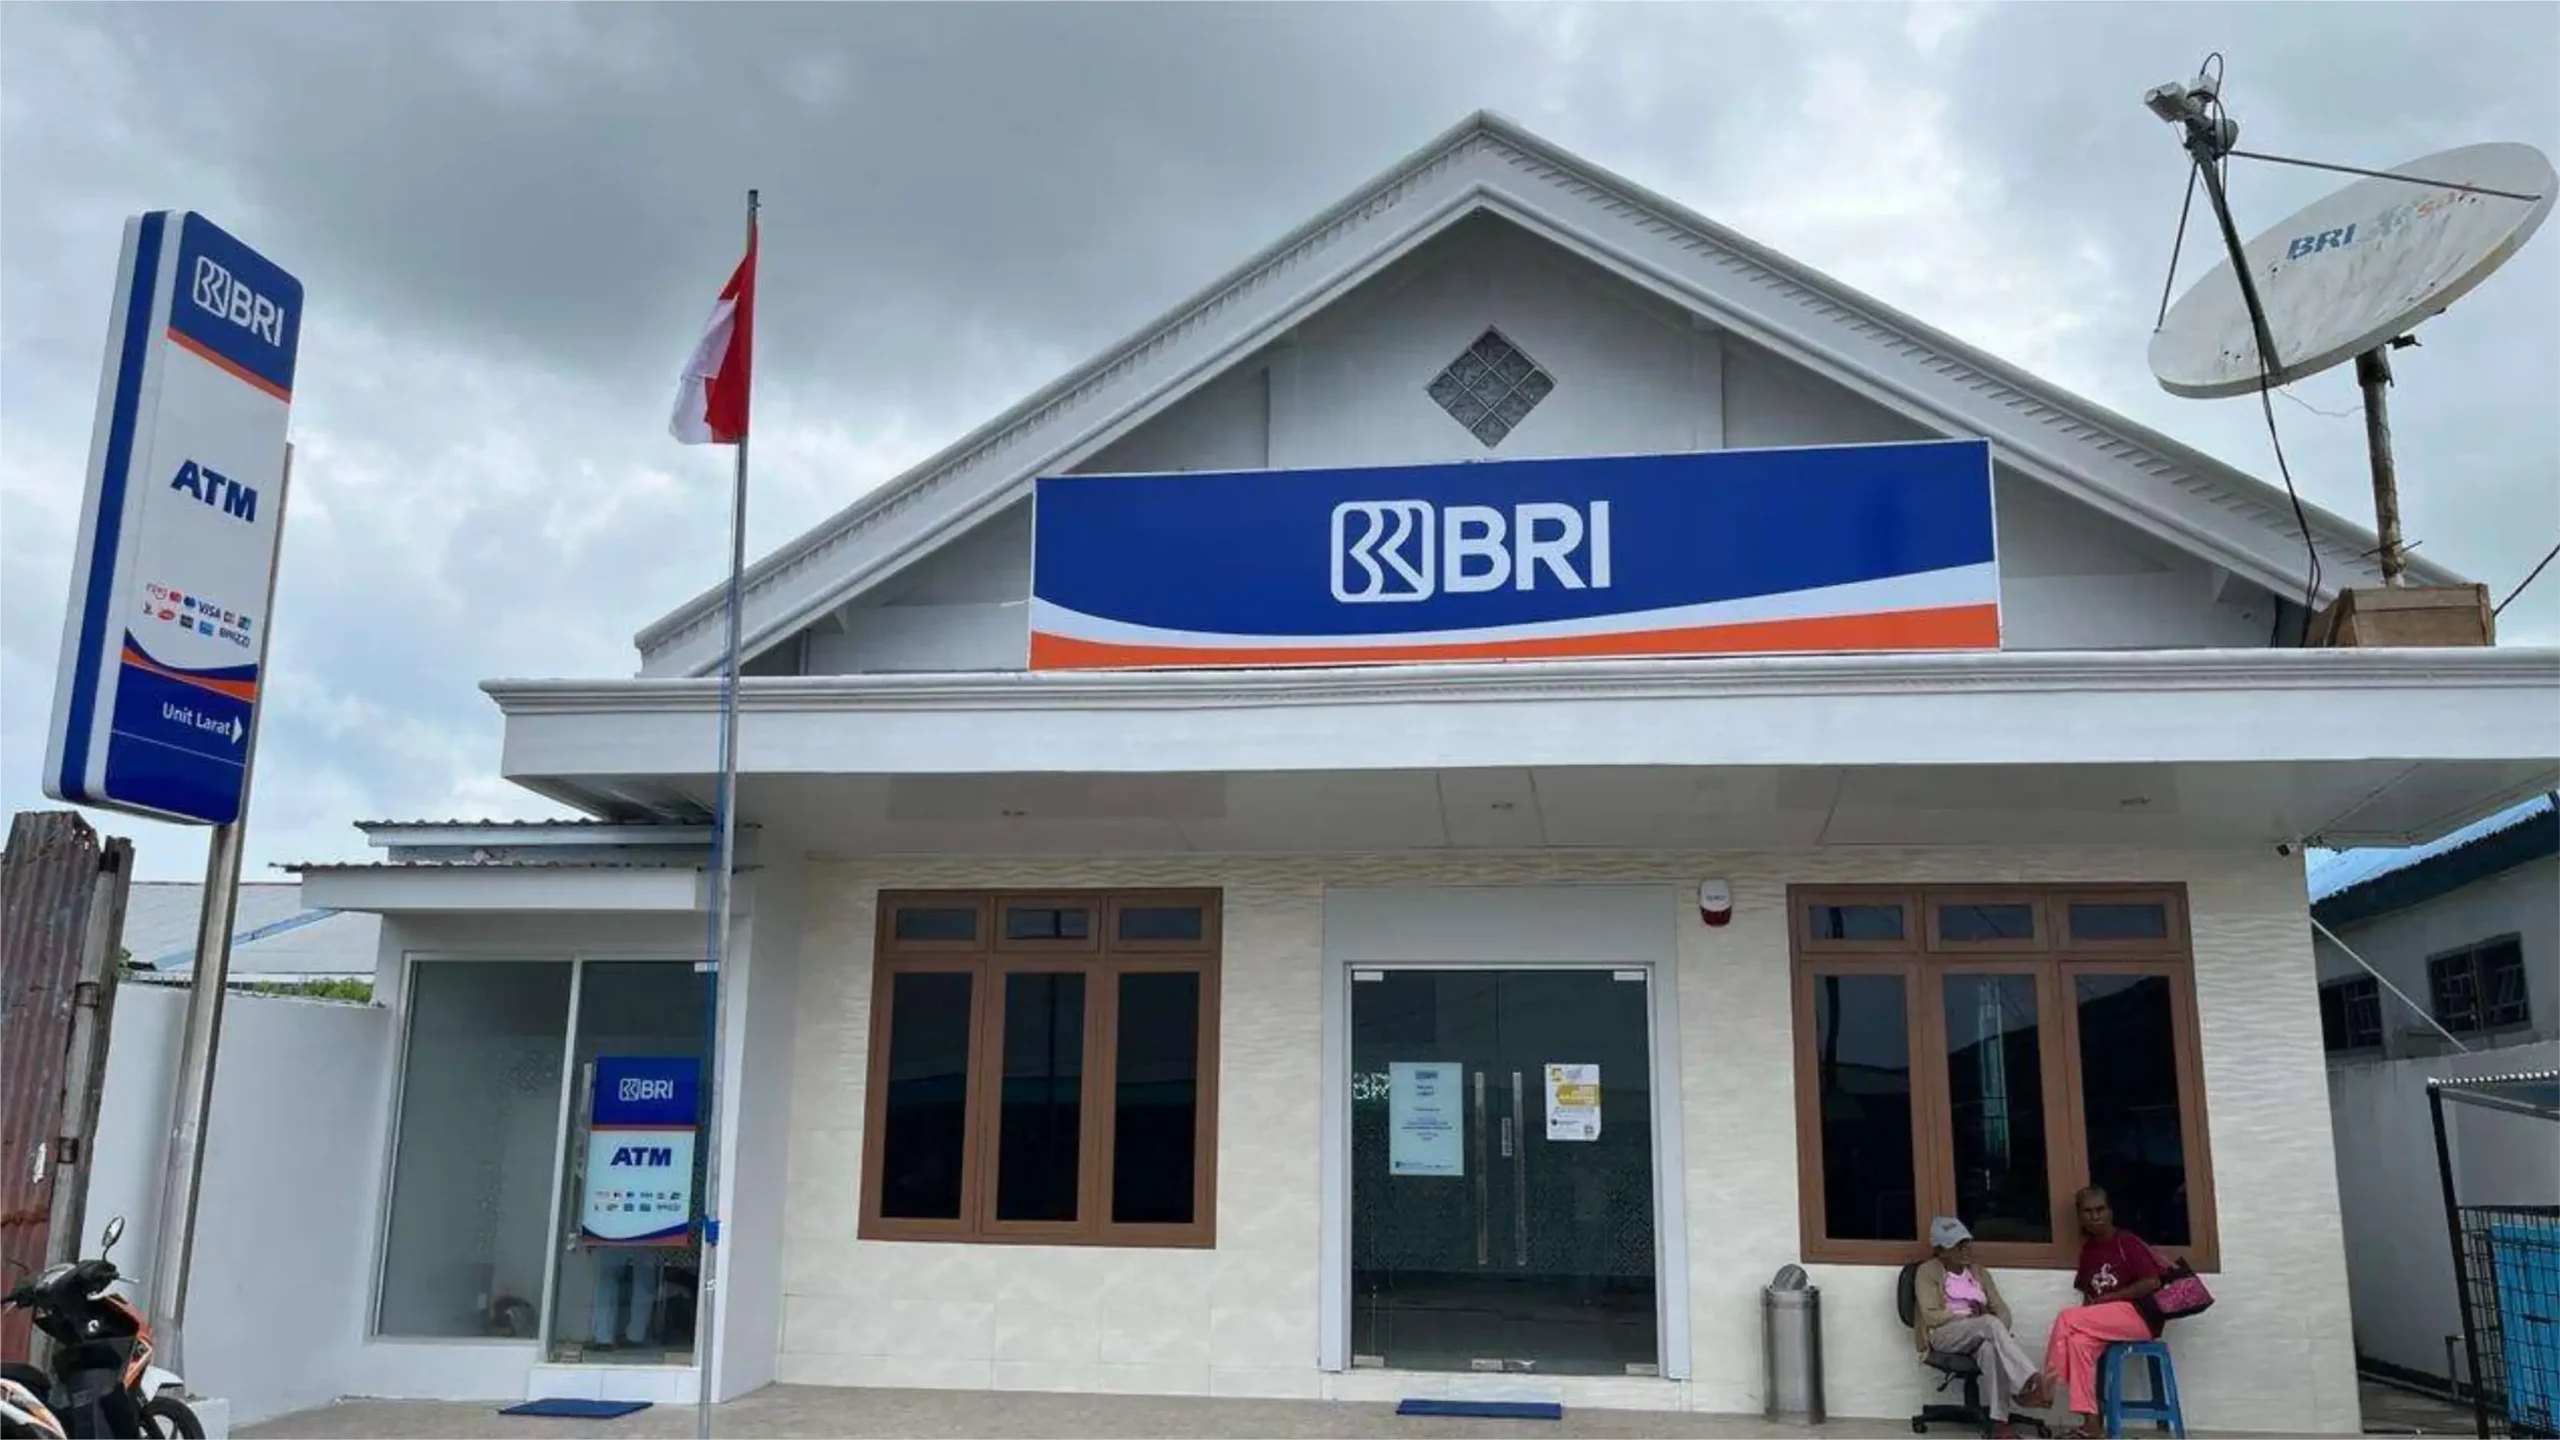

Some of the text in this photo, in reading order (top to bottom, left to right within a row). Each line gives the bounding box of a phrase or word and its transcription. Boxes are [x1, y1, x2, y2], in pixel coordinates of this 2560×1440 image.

[2287, 223, 2356, 260] BRI
[229, 280, 286, 347] BRI
[170, 458, 258, 524] ATM
[1443, 500, 1612, 593] BRI
[199, 600, 222, 619] VISA
[163, 701, 232, 736] Unit Larat
[641, 1079, 674, 1100] BRI
[610, 1146, 672, 1167] ATM
